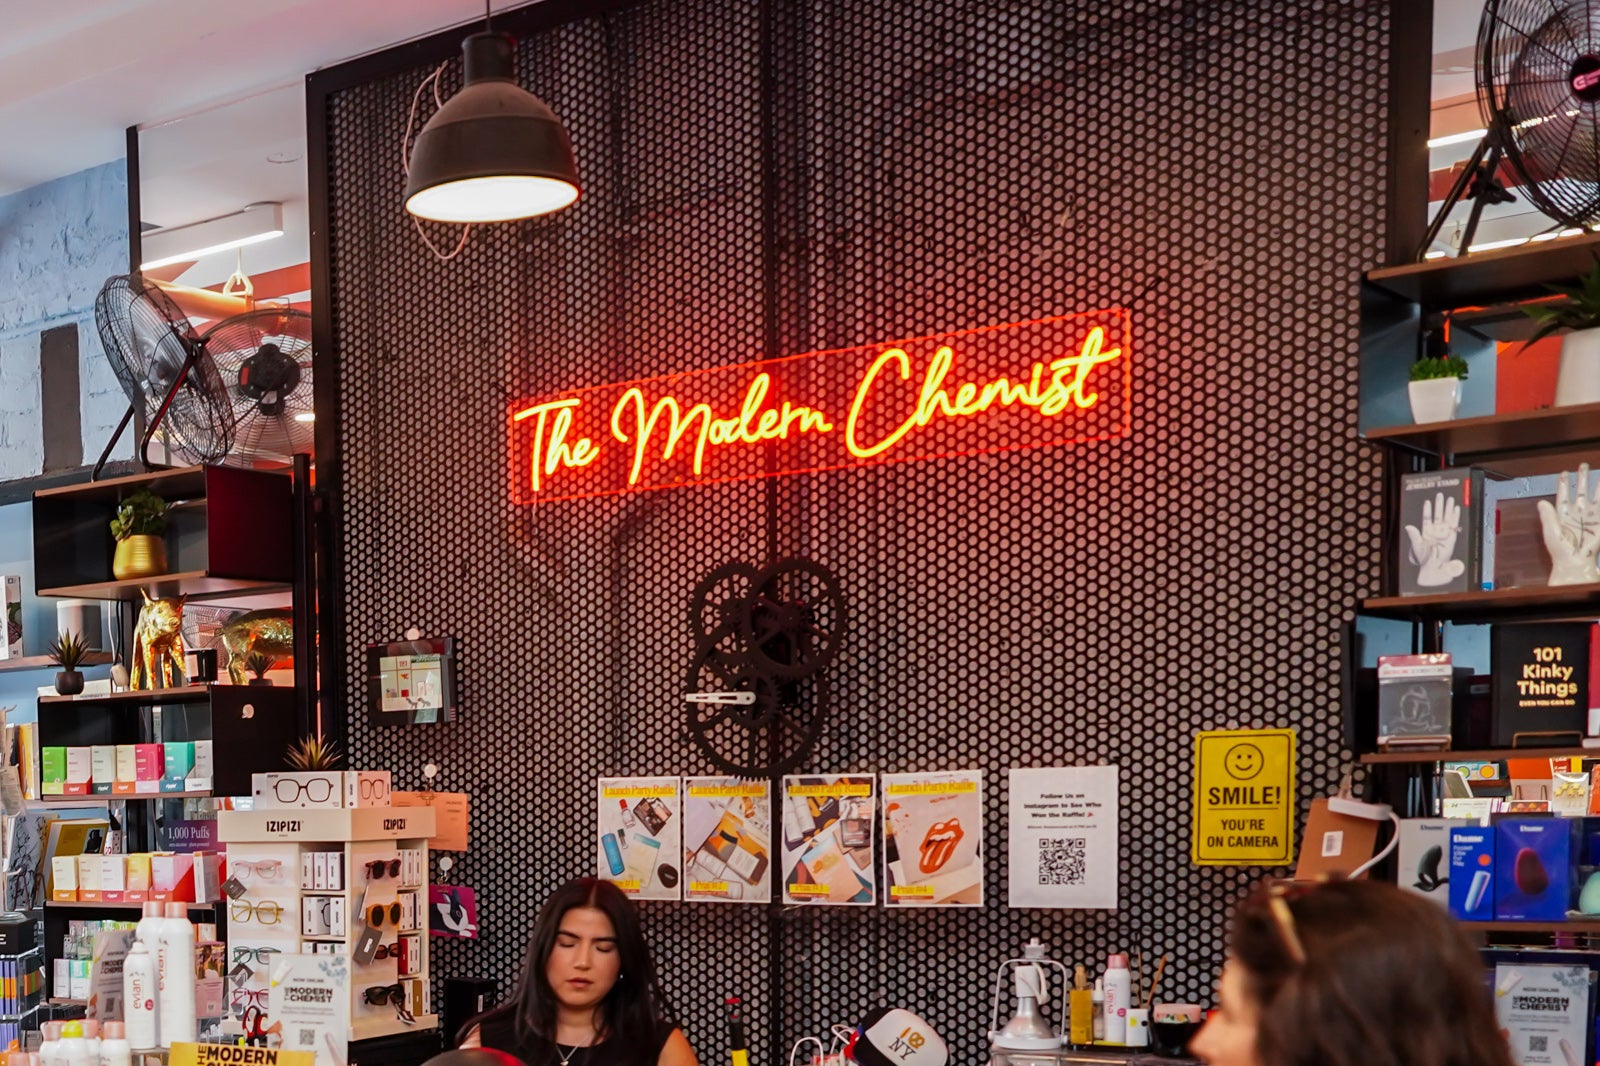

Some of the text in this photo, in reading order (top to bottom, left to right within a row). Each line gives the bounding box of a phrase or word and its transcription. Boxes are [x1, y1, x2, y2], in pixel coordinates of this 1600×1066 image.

[514, 326, 1122, 492] The Modern Chemist
[1533, 646, 1562, 662] 101
[1523, 663, 1574, 682] Kinky
[1517, 680, 1578, 698] Things
[1208, 786, 1281, 806] SMILE!
[266, 820, 301, 833] IZIPIZI
[383, 818, 406, 831] IZIPIZI
[1221, 818, 1265, 832] YOU'RE
[168, 825, 210, 841] 1,000 Puffs
[1207, 835, 1280, 848] ON CAMERA
[133, 979, 142, 1010] evian
[290, 987, 333, 995] MODERN
[290, 995, 333, 1003] CHEMIST
[1520, 996, 1569, 1004] MODERN
[1520, 1003, 1568, 1011] CHEMIST
[207, 1046, 278, 1065] MODERN
[888, 1038, 917, 1061] NY
